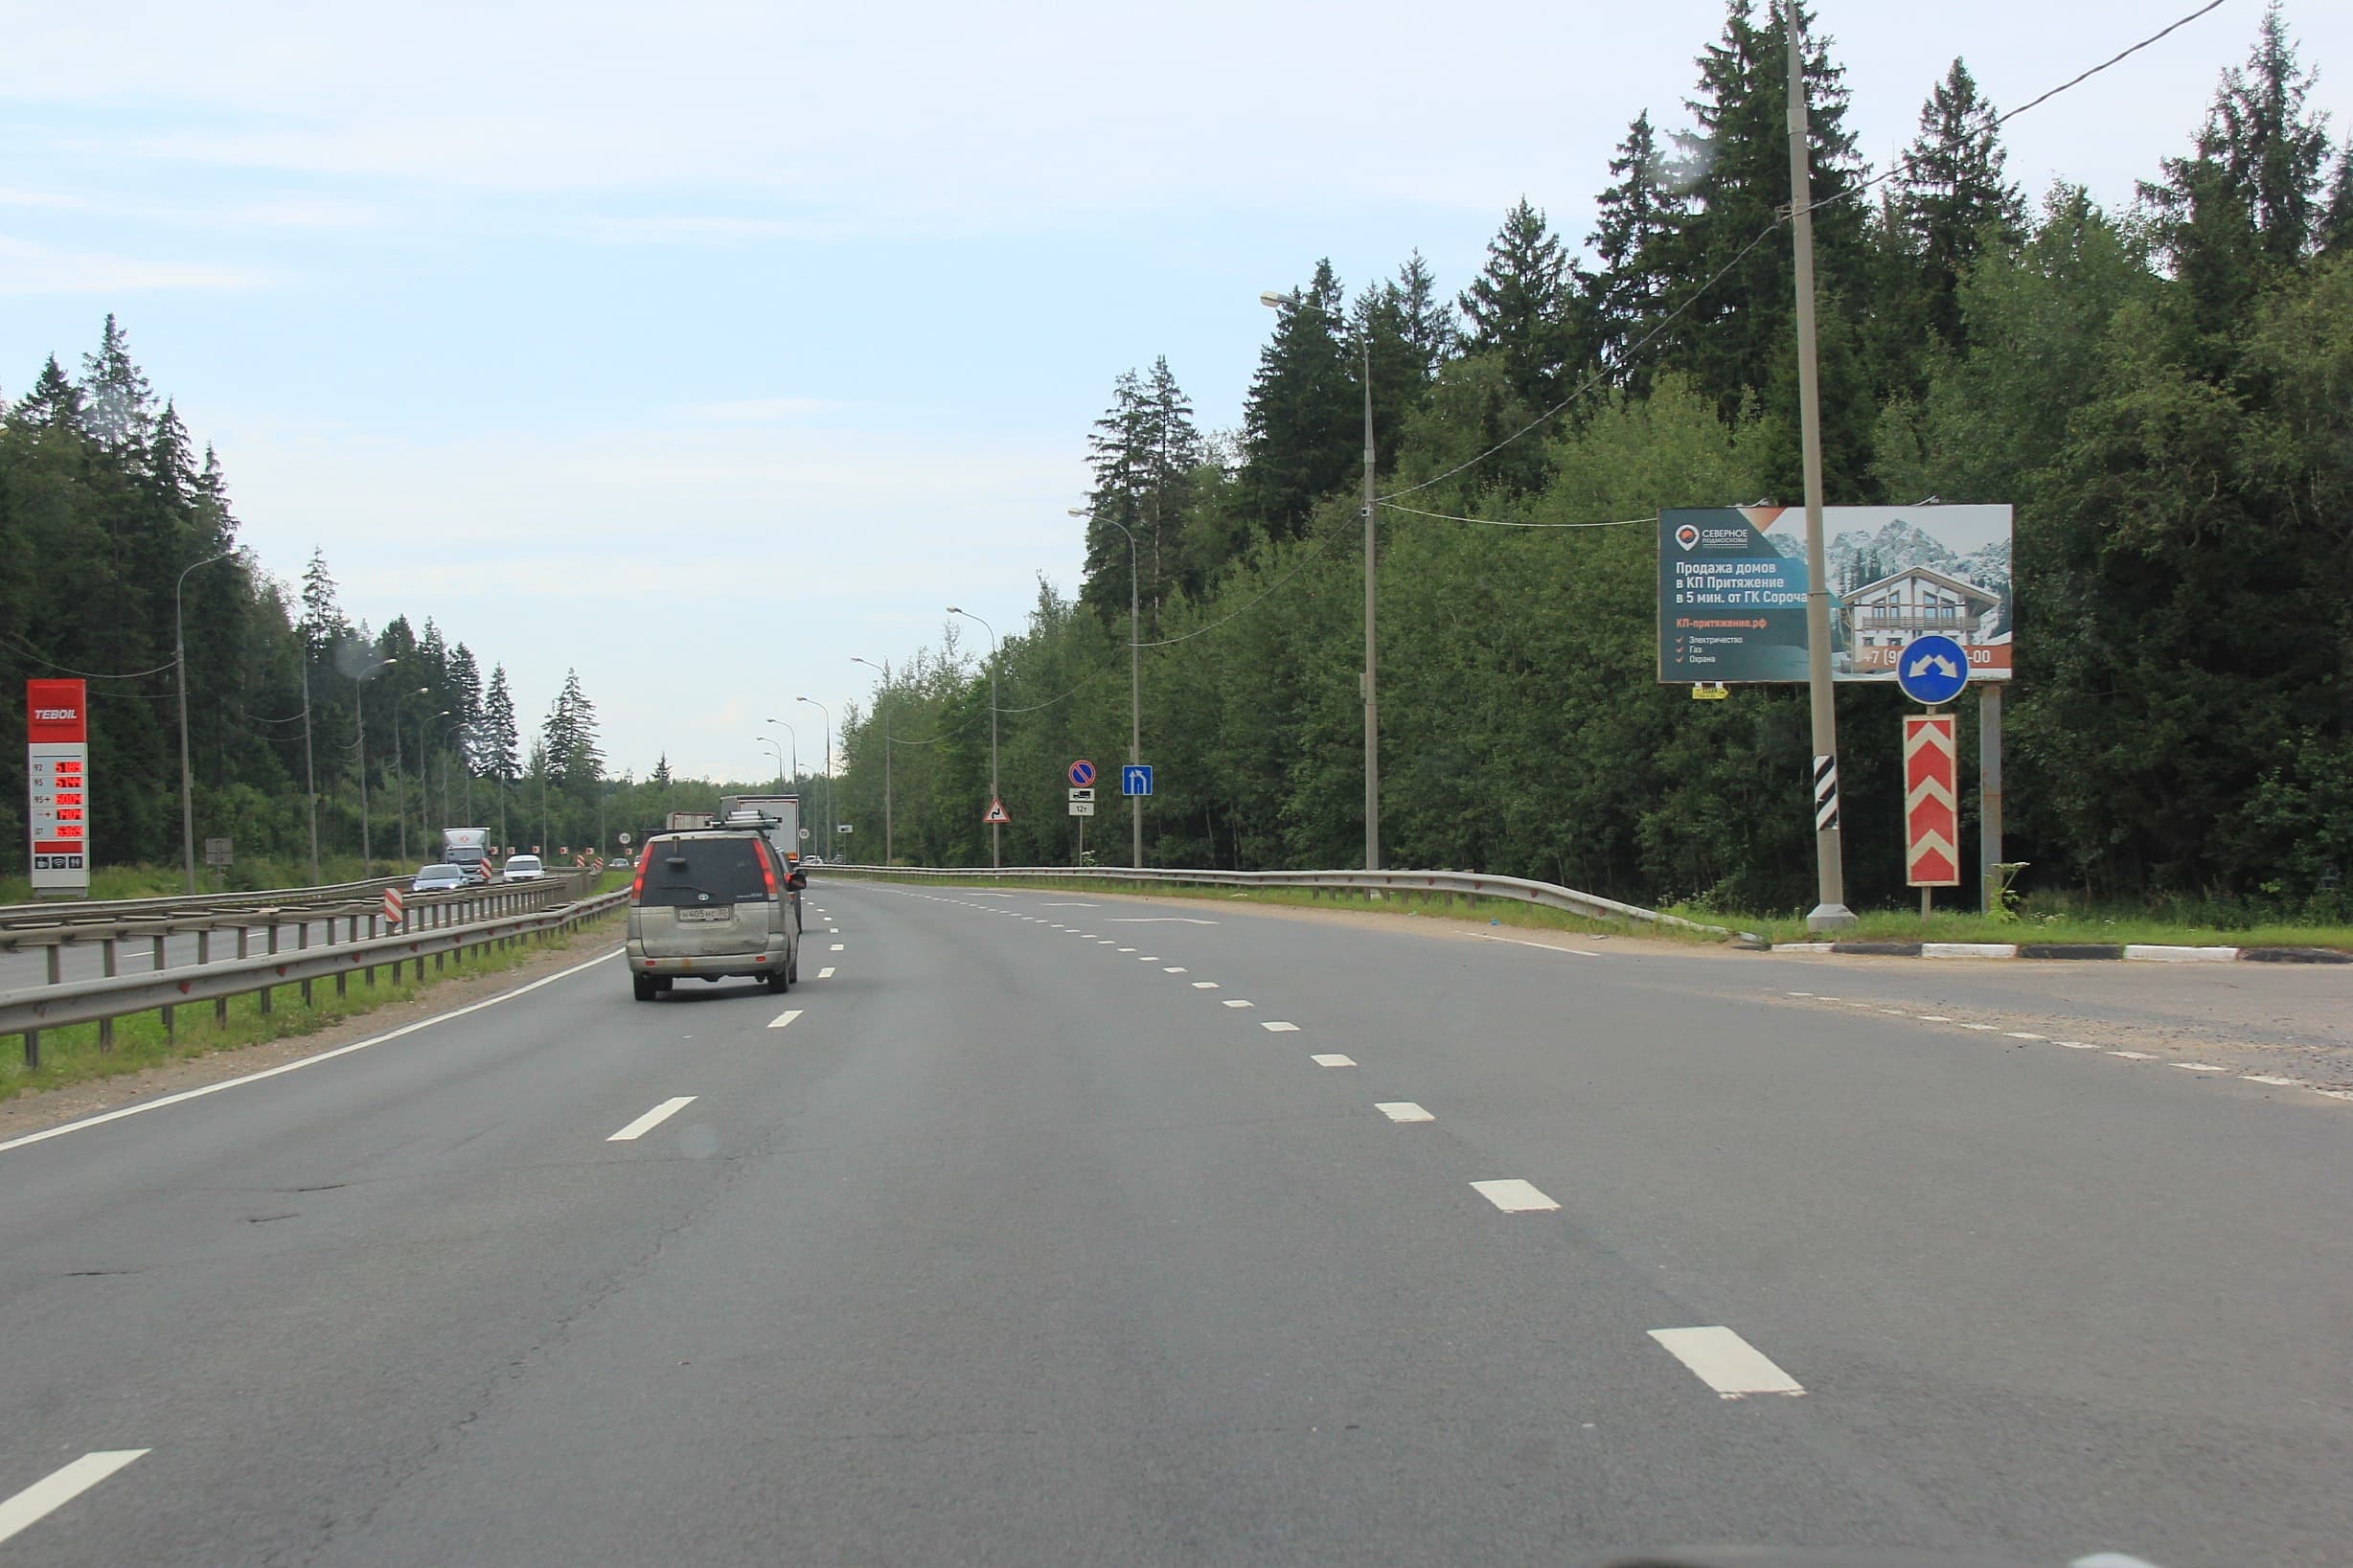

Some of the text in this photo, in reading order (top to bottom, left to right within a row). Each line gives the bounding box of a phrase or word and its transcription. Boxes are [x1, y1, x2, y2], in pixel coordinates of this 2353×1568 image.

[1702, 529, 1748, 538] СЕВЕРНОЕ
[1676, 561, 1776, 576] Продажа домов
[1676, 577, 1784, 590] в КП Притяжение
[1676, 594, 1683, 603] в
[1686, 592, 1694, 603] 5
[1697, 594, 1725, 603] мин.
[1727, 593, 1741, 602] от
[1745, 591, 1760, 602] ГК
[1676, 618, 1767, 629] КП-притяжение.рф
[1689, 635, 1744, 645] Электричество
[1689, 655, 1716, 664] Охрана
[34, 709, 77, 719] TEBOIL
[34, 778, 44, 786] 95
